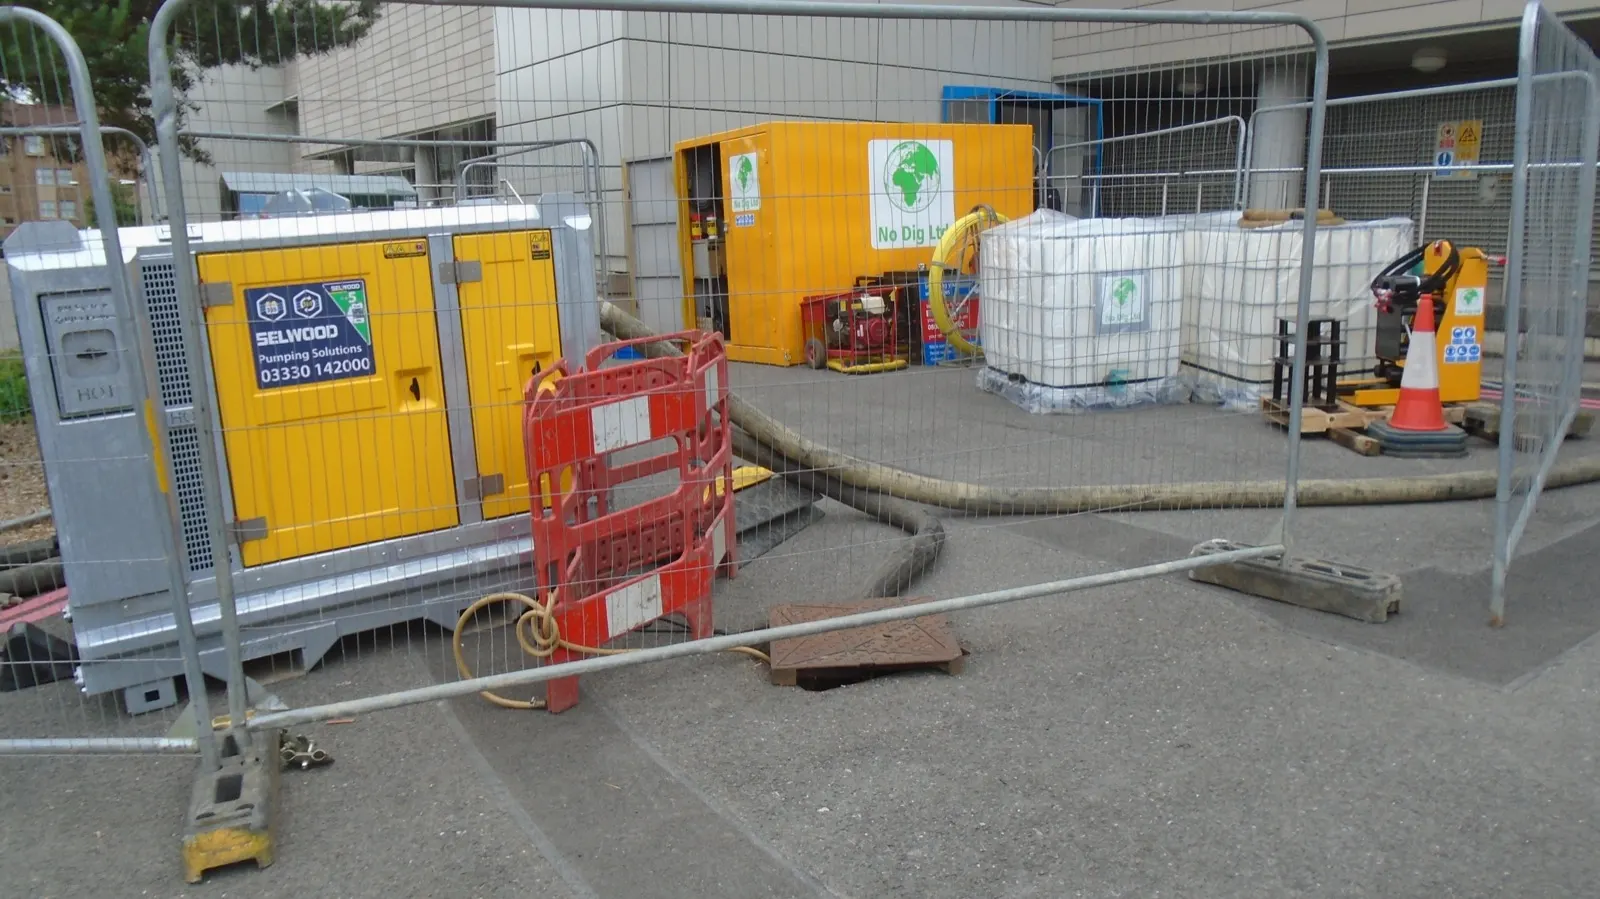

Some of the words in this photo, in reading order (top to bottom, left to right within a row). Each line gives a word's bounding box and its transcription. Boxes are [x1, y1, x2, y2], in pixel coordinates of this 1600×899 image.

[878, 226, 898, 242] No
[902, 224, 924, 244] Dig
[330, 284, 360, 292] SELWOOD
[348, 291, 356, 304] 5
[256, 324, 338, 346] SELWOOD
[259, 352, 310, 364] Pumping
[312, 344, 362, 358] Solutions
[261, 365, 310, 382] 03330
[315, 358, 370, 376] 142000
